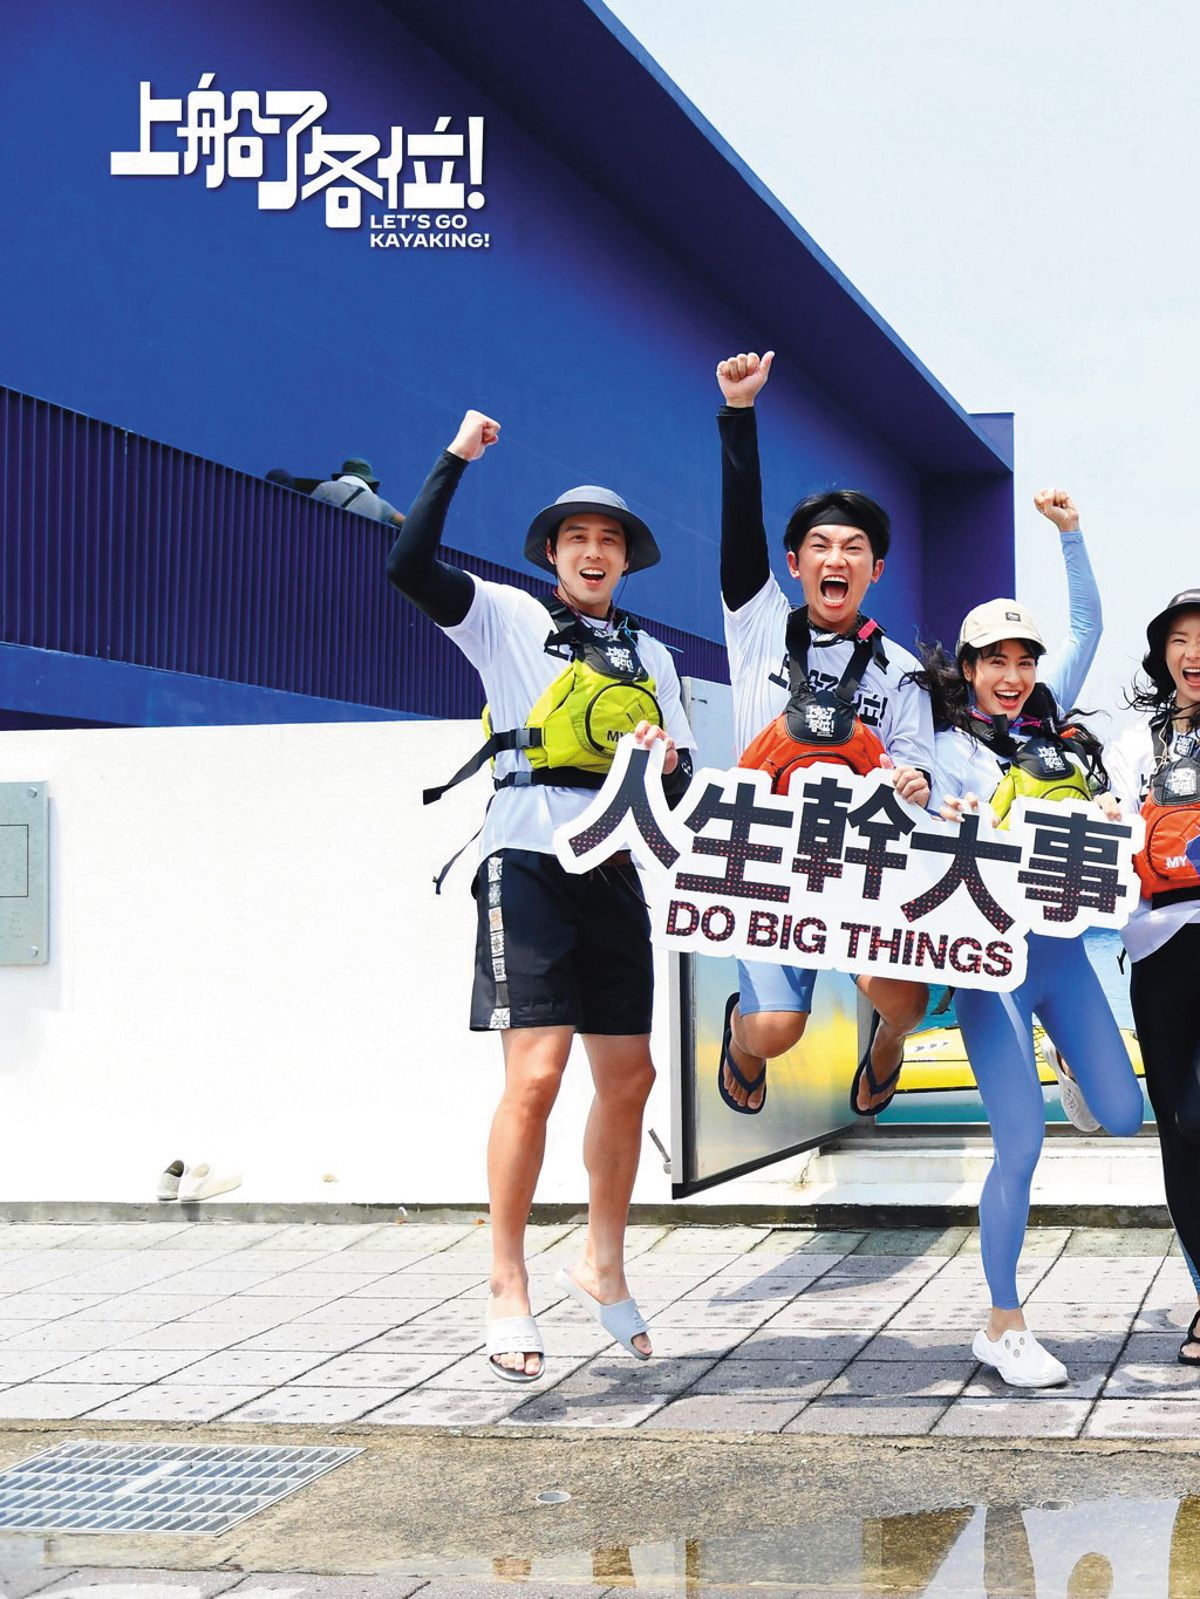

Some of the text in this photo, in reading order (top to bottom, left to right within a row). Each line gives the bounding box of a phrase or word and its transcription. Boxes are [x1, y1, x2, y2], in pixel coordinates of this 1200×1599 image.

[568, 748, 1133, 935] 人生幹大事
[665, 899, 1014, 978] DO BIG THINGS
